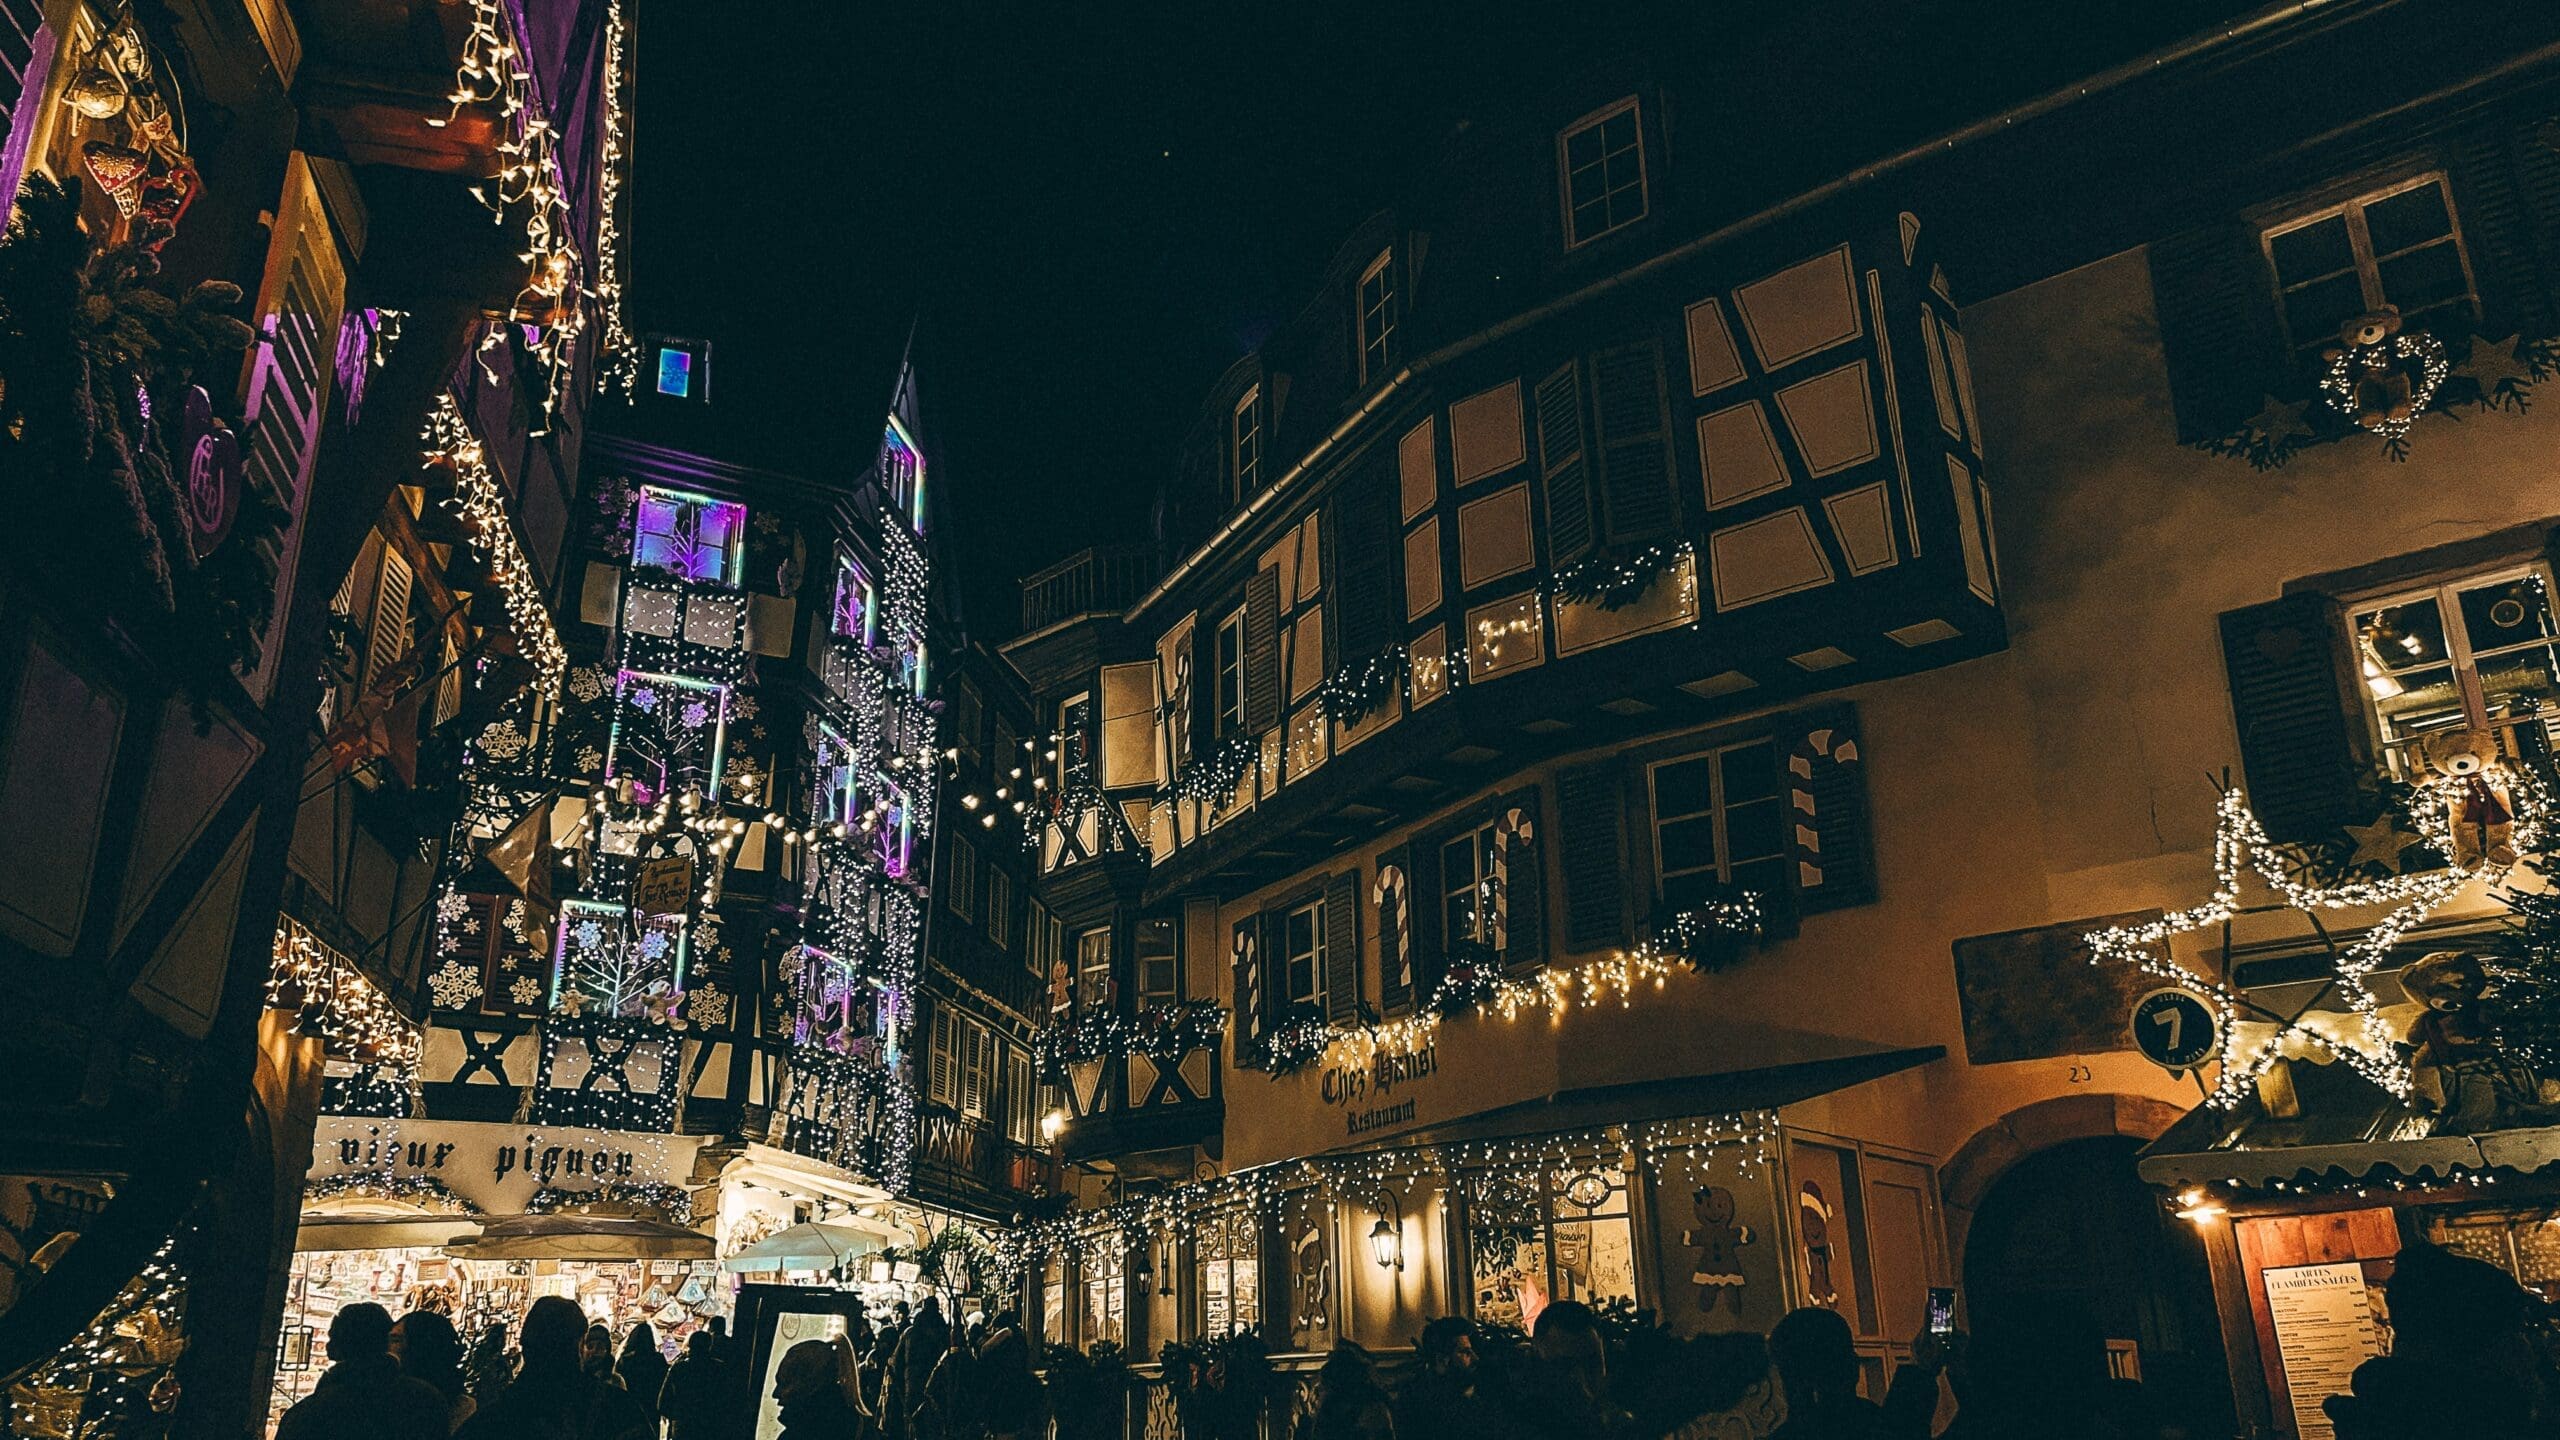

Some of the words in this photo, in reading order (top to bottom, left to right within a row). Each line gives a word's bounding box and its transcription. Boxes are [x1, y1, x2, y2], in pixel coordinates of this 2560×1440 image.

[2152, 1007, 2182, 1051] 7
[1321, 1065, 1365, 1107] Chez
[2069, 1066, 2091, 1083] 23
[1347, 1097, 1415, 1135] Restaurant
[493, 1134, 633, 1184] pignon
[2295, 1268, 2331, 1278] TARTES
